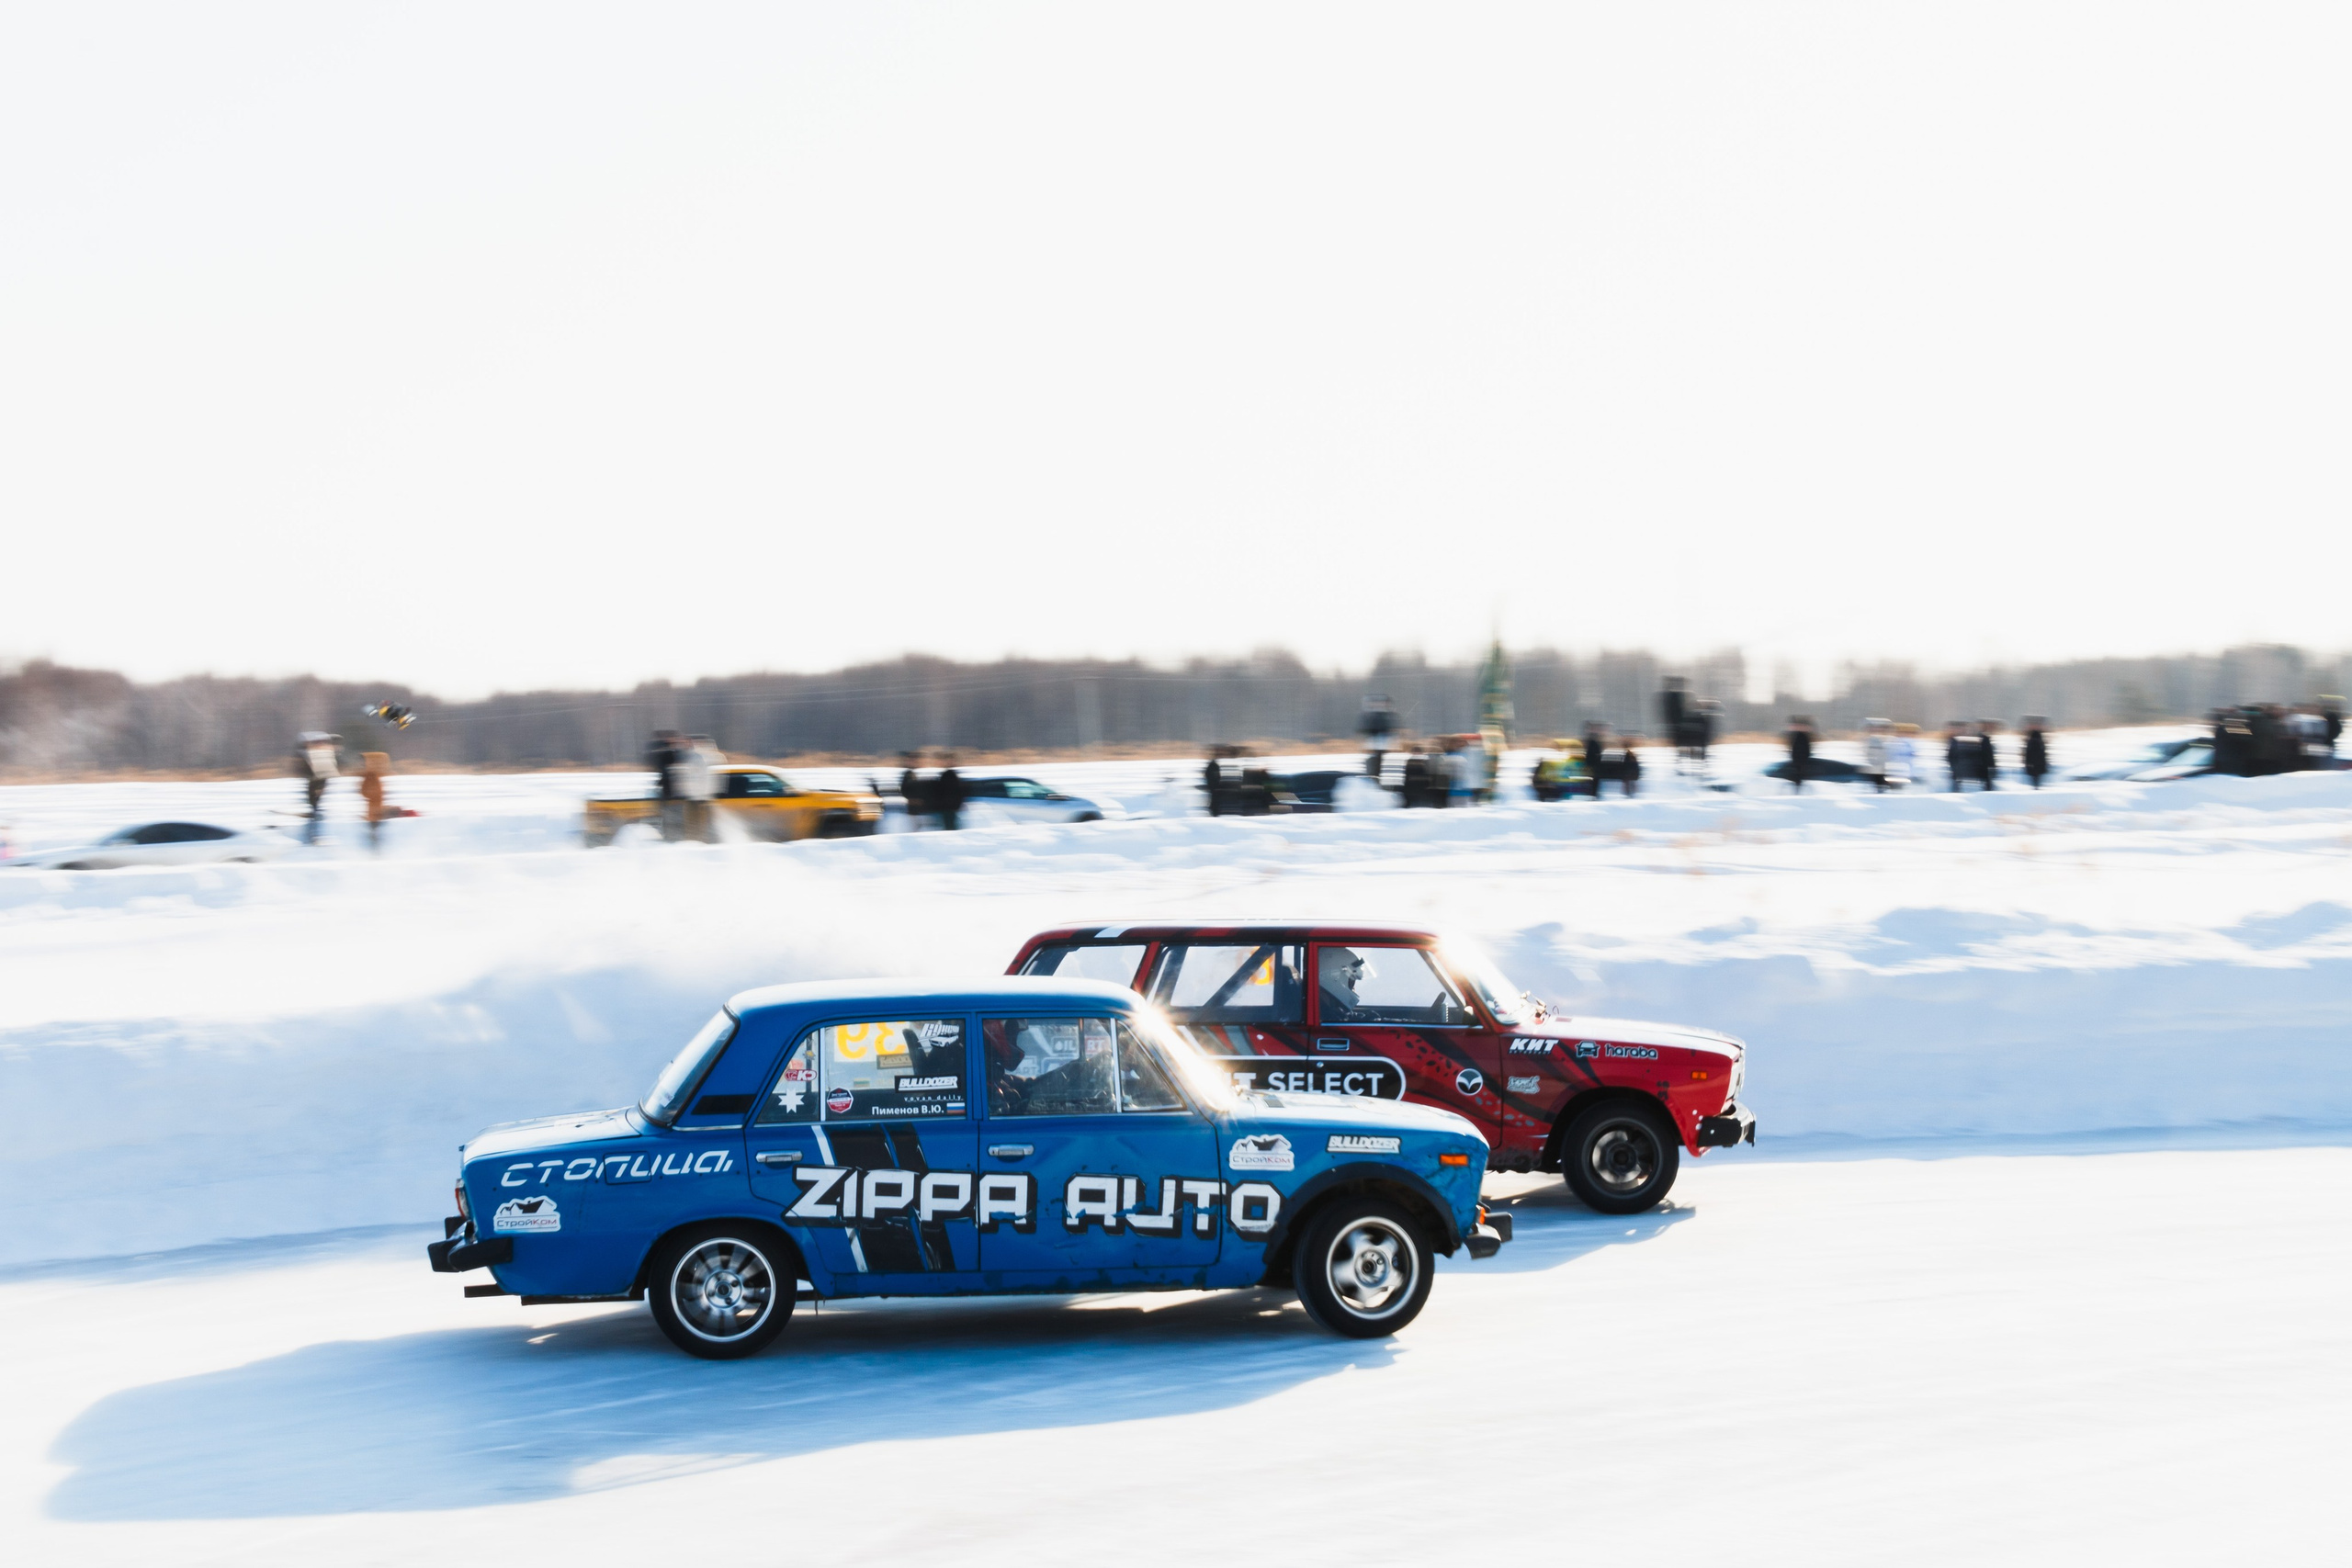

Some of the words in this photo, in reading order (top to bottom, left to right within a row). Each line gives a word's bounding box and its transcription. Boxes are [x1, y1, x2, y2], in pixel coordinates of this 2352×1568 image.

[1510, 1038, 1559, 1051] КИТ
[1605, 1043, 1657, 1059] haraba
[899, 1076, 958, 1089] BULLDOZER
[1268, 1072, 1385, 1095] SELECT
[872, 1106, 919, 1115] Пименов
[922, 1104, 944, 1113] В.Ю.
[1328, 1135, 1401, 1153] BULLDOZER
[784, 1167, 1031, 1226] ZIPPA
[1066, 1173, 1283, 1233] AUTO
